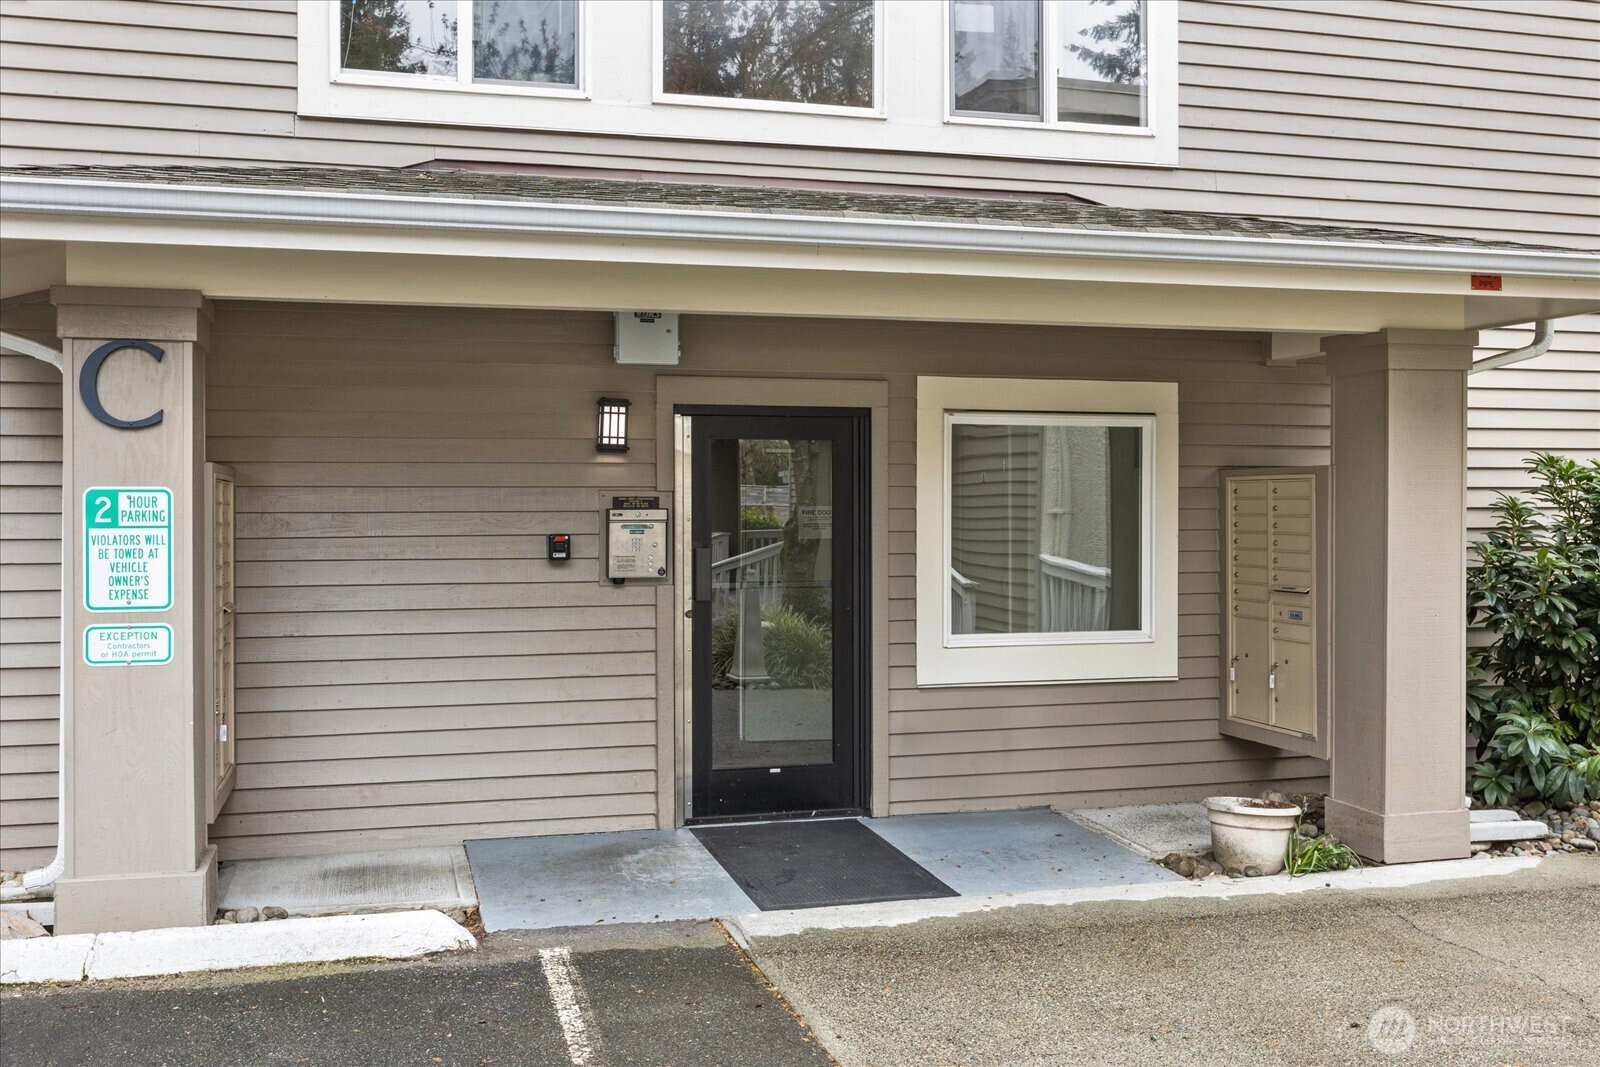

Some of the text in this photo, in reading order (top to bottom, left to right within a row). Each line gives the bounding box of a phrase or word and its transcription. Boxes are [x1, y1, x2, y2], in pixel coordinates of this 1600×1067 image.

[1479, 280, 1495, 288] PIPE
[79, 339, 165, 430] C
[129, 496, 158, 508] HOUR
[94, 496, 112, 523] 2
[121, 510, 166, 523] PARKING
[91, 535, 166, 546] VIOLATORS WILL
[98, 548, 159, 560] BE TOWED AT
[110, 562, 148, 573] VEHICLE
[108, 575, 150, 587] OWNER'S
[109, 589, 149, 600] EXPENSE
[99, 631, 158, 641] EXCEPTION
[107, 642, 151, 650] Contractors
[111, 650, 129, 658] HOA
[132, 650, 157, 659] permit
